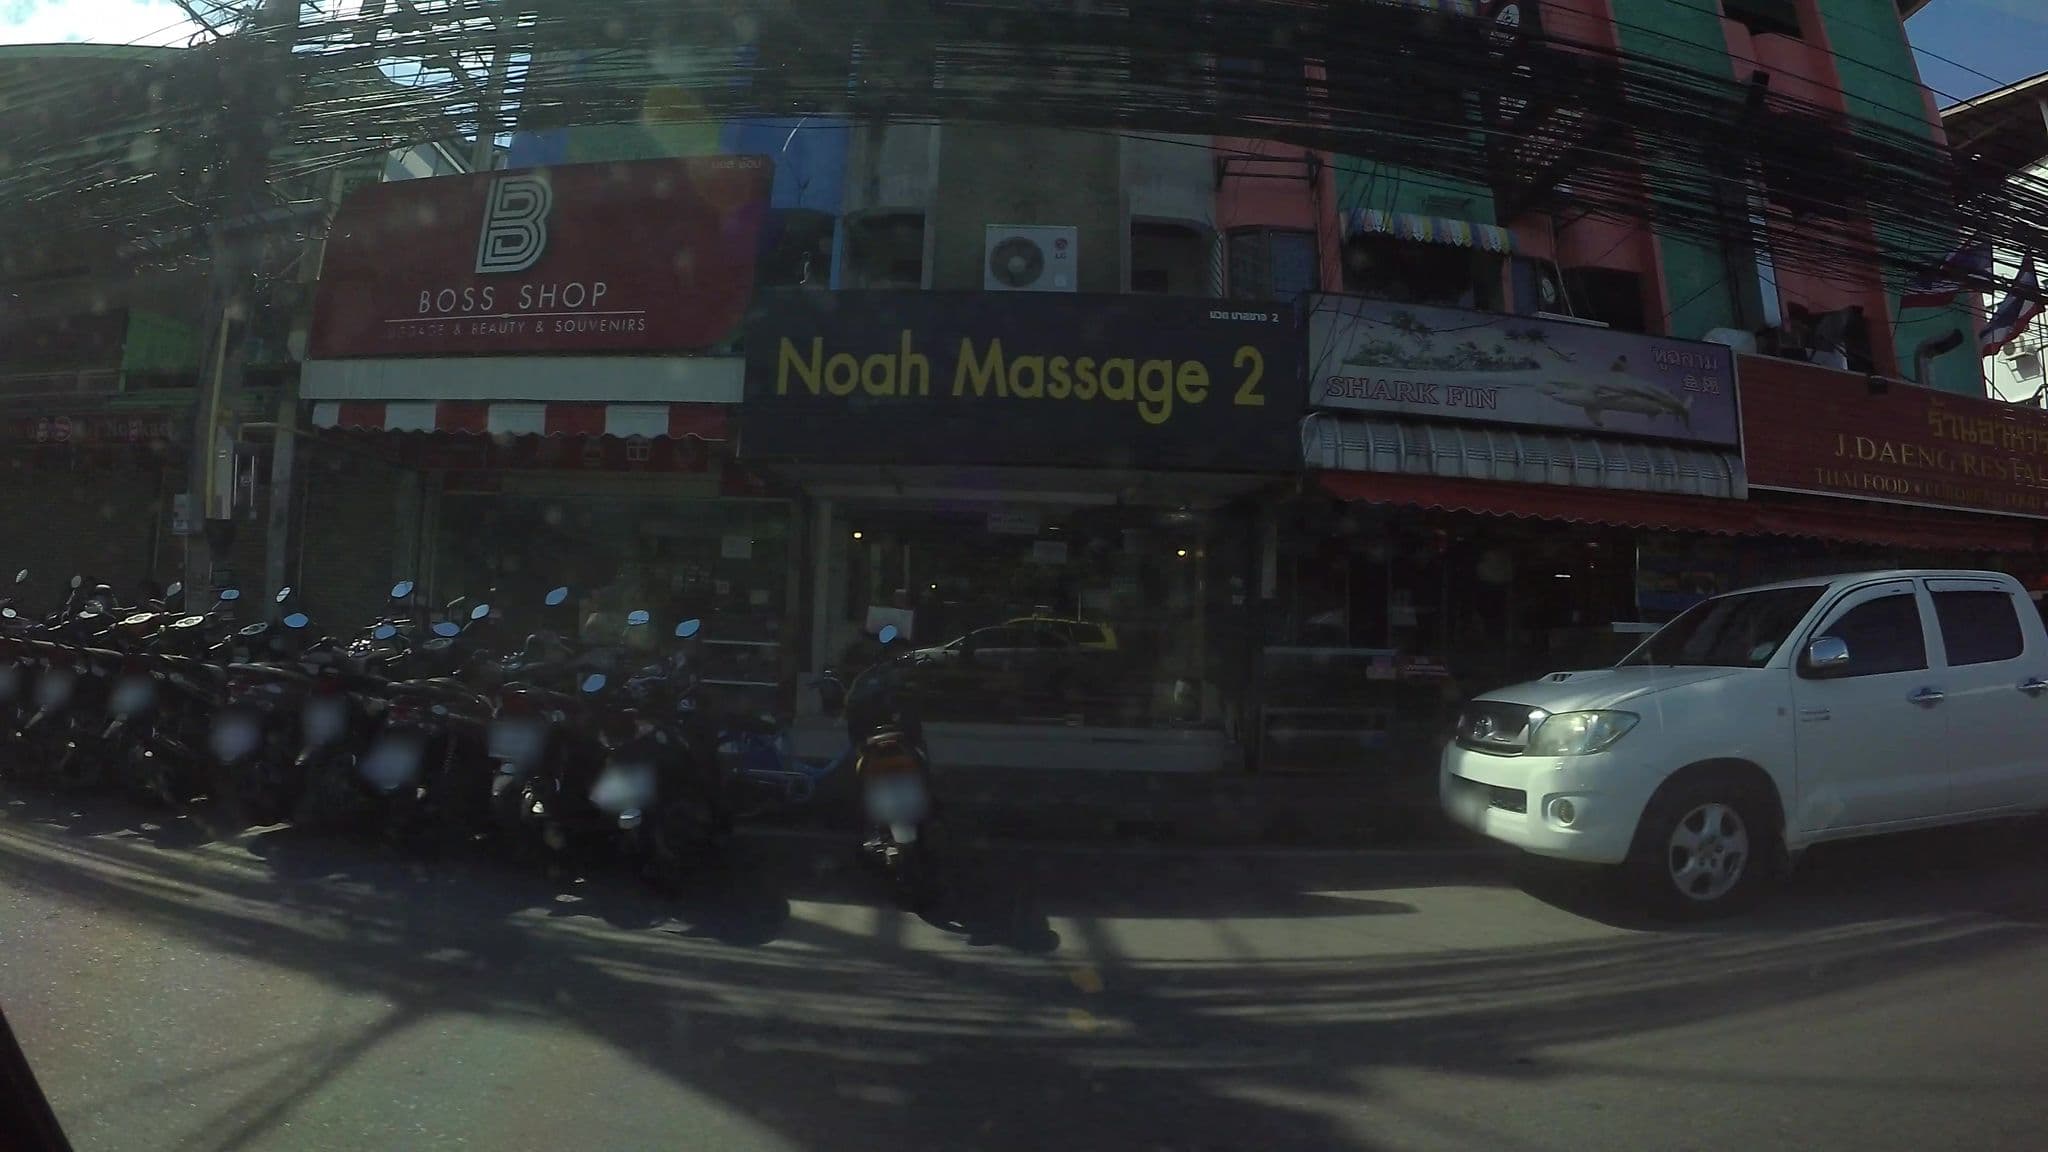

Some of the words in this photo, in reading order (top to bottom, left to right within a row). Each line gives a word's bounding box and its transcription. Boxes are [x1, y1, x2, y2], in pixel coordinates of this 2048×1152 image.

[418, 286, 496, 313] BOSS
[518, 281, 608, 310] SHOP
[471, 320, 526, 336] BEAUTY
[534, 319, 545, 334] &
[554, 317, 647, 334] SOUVENIRS
[1271, 312, 1280, 323] 2
[775, 328, 931, 398] Noah
[951, 336, 1209, 424] Massage
[1232, 344, 1266, 406] 2
[1326, 376, 1440, 406] SHARK
[1446, 386, 1497, 410] FIN
[1862, 474, 1910, 496] FOOD
